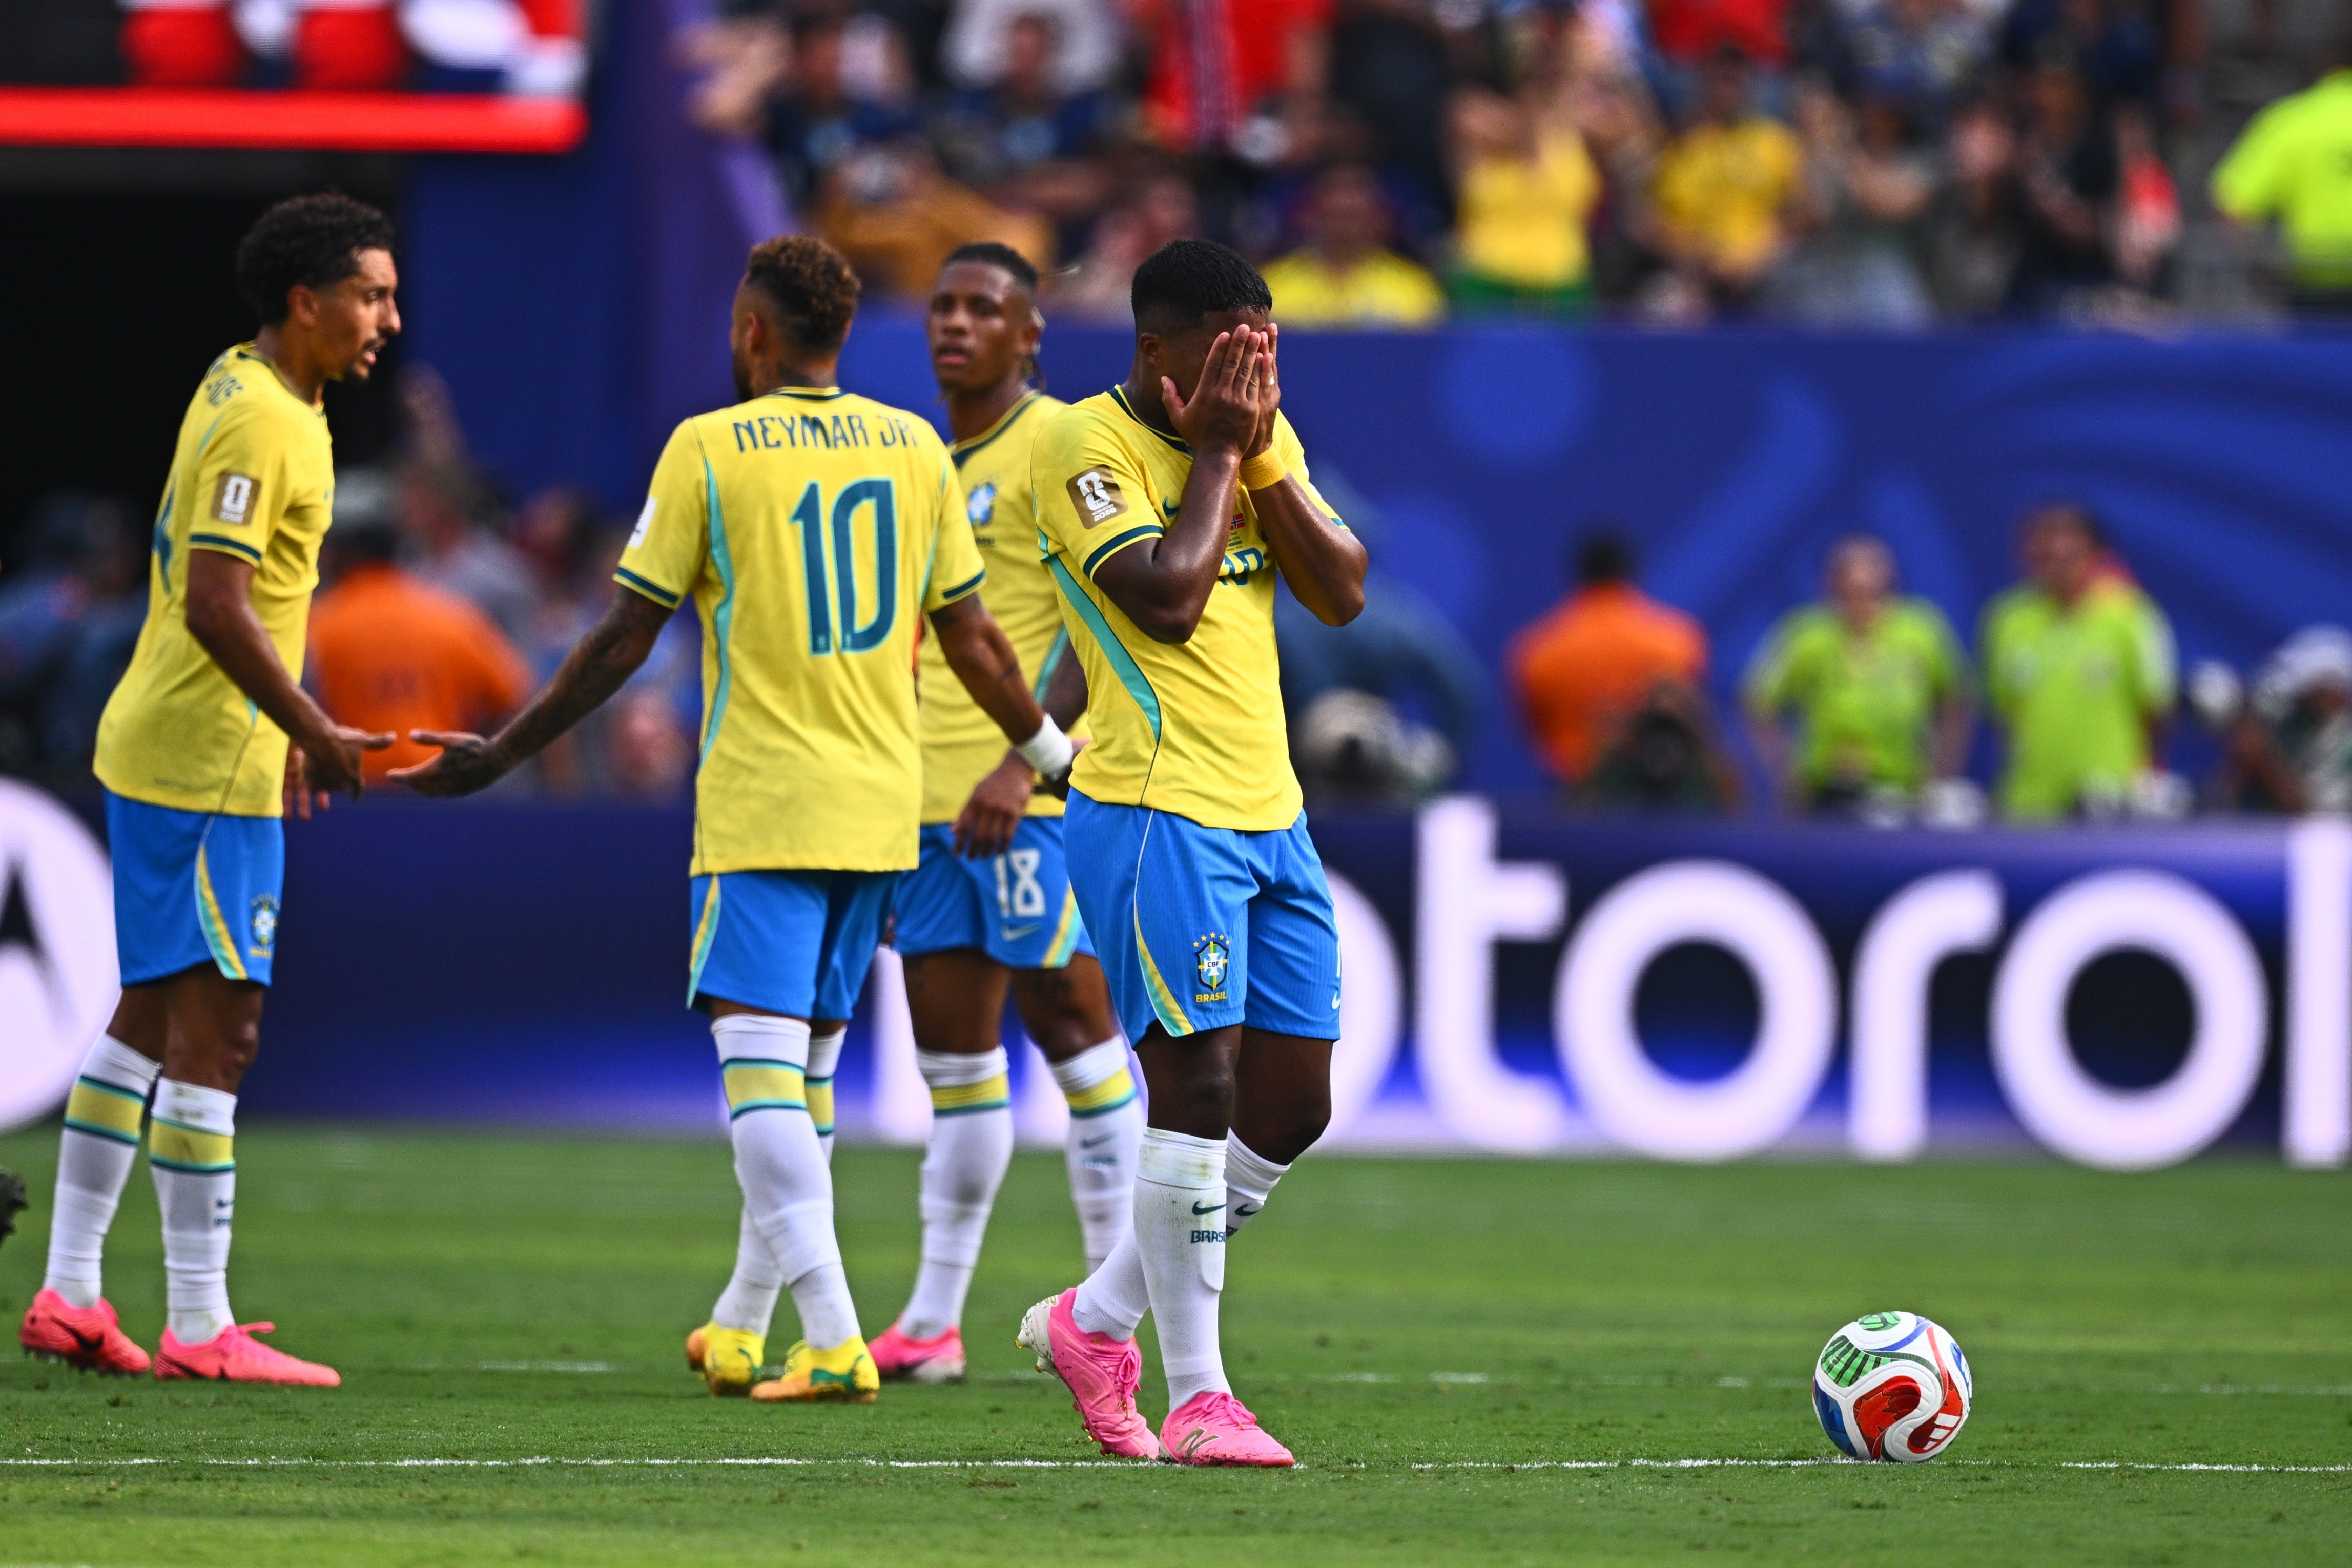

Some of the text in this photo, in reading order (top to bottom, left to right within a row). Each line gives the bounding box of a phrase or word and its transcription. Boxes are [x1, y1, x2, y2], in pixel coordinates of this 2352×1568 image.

[733, 415, 918, 452] NEYMAR JR
[1092, 507, 1106, 516] WORLD
[1094, 507, 1117, 521] 2026
[788, 477, 898, 656] 10
[993, 848, 1046, 918] 18
[1196, 991, 1227, 1003] BRASIL
